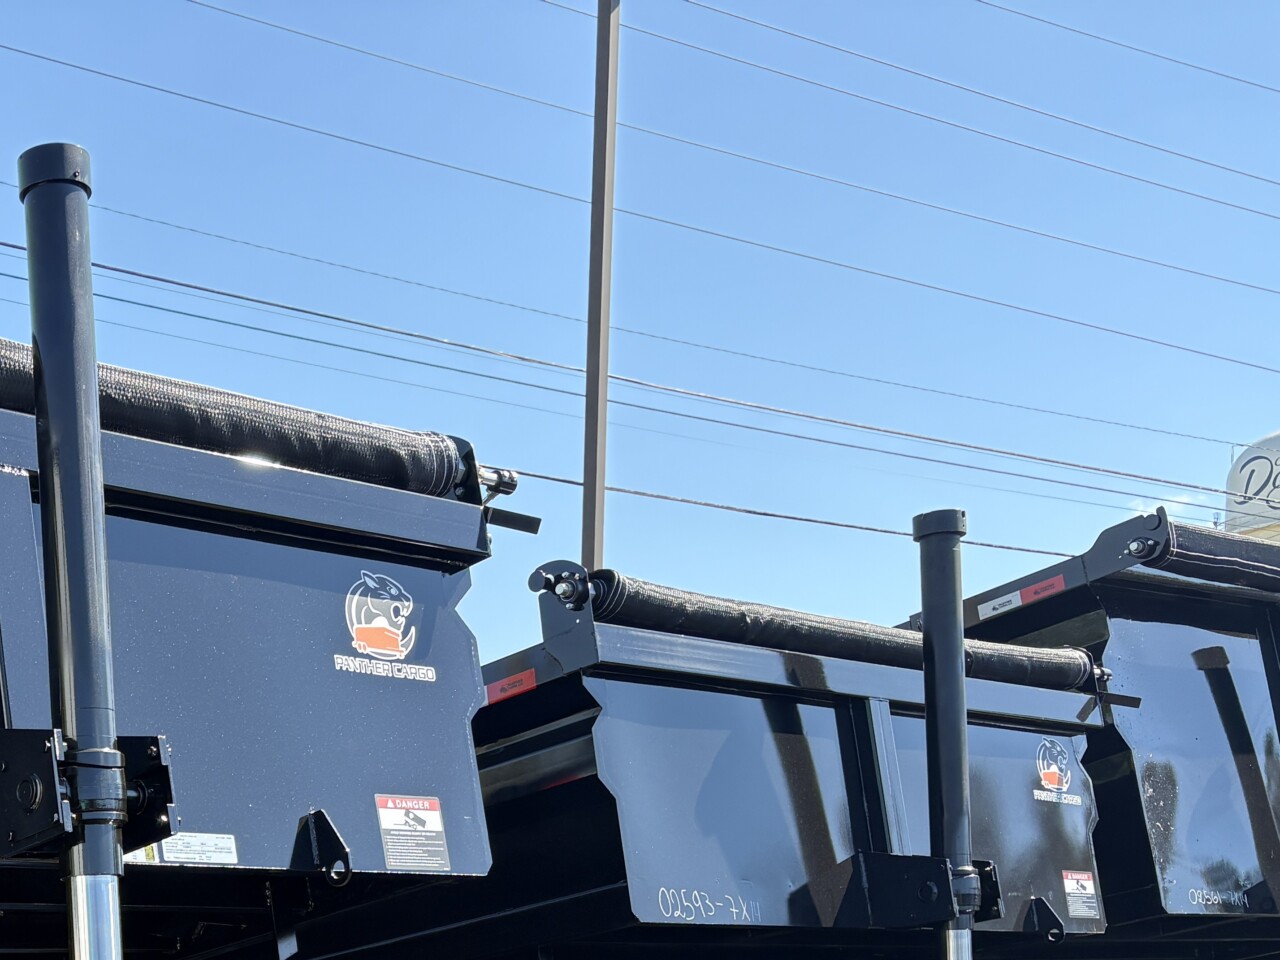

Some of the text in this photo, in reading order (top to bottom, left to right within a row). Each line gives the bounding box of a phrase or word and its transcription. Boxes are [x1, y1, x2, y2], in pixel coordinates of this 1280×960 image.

[334, 655, 436, 682] PANTHER CARGO
[395, 799, 430, 809] DANGER
[658, 887, 762, 922] 02593-7X14
